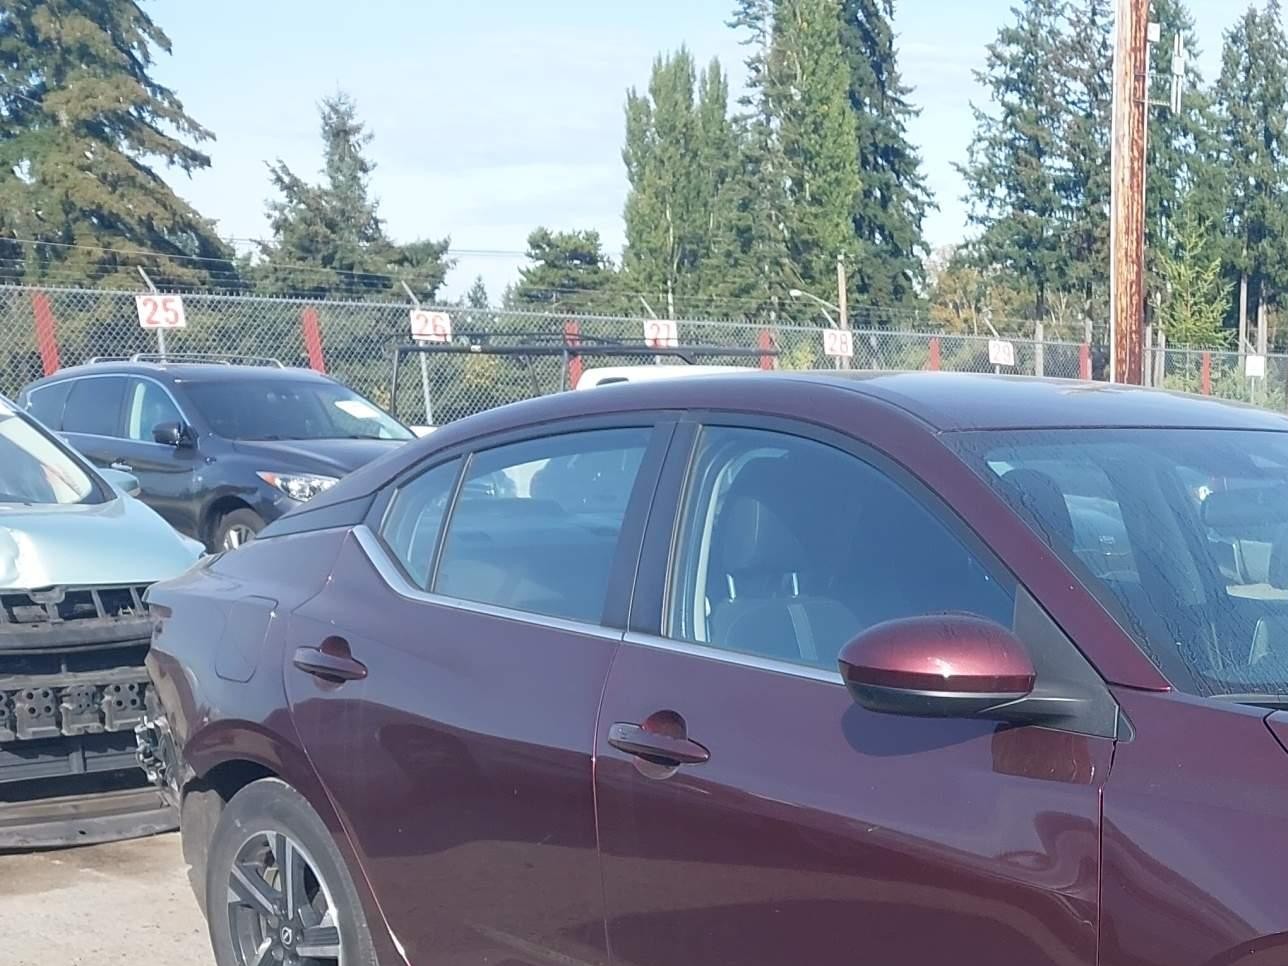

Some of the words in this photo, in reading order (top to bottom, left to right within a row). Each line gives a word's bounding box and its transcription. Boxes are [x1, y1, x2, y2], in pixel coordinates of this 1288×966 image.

[142, 298, 179, 325] 25
[415, 313, 447, 336] 26
[650, 323, 671, 348] 27
[829, 333, 849, 353] 28
